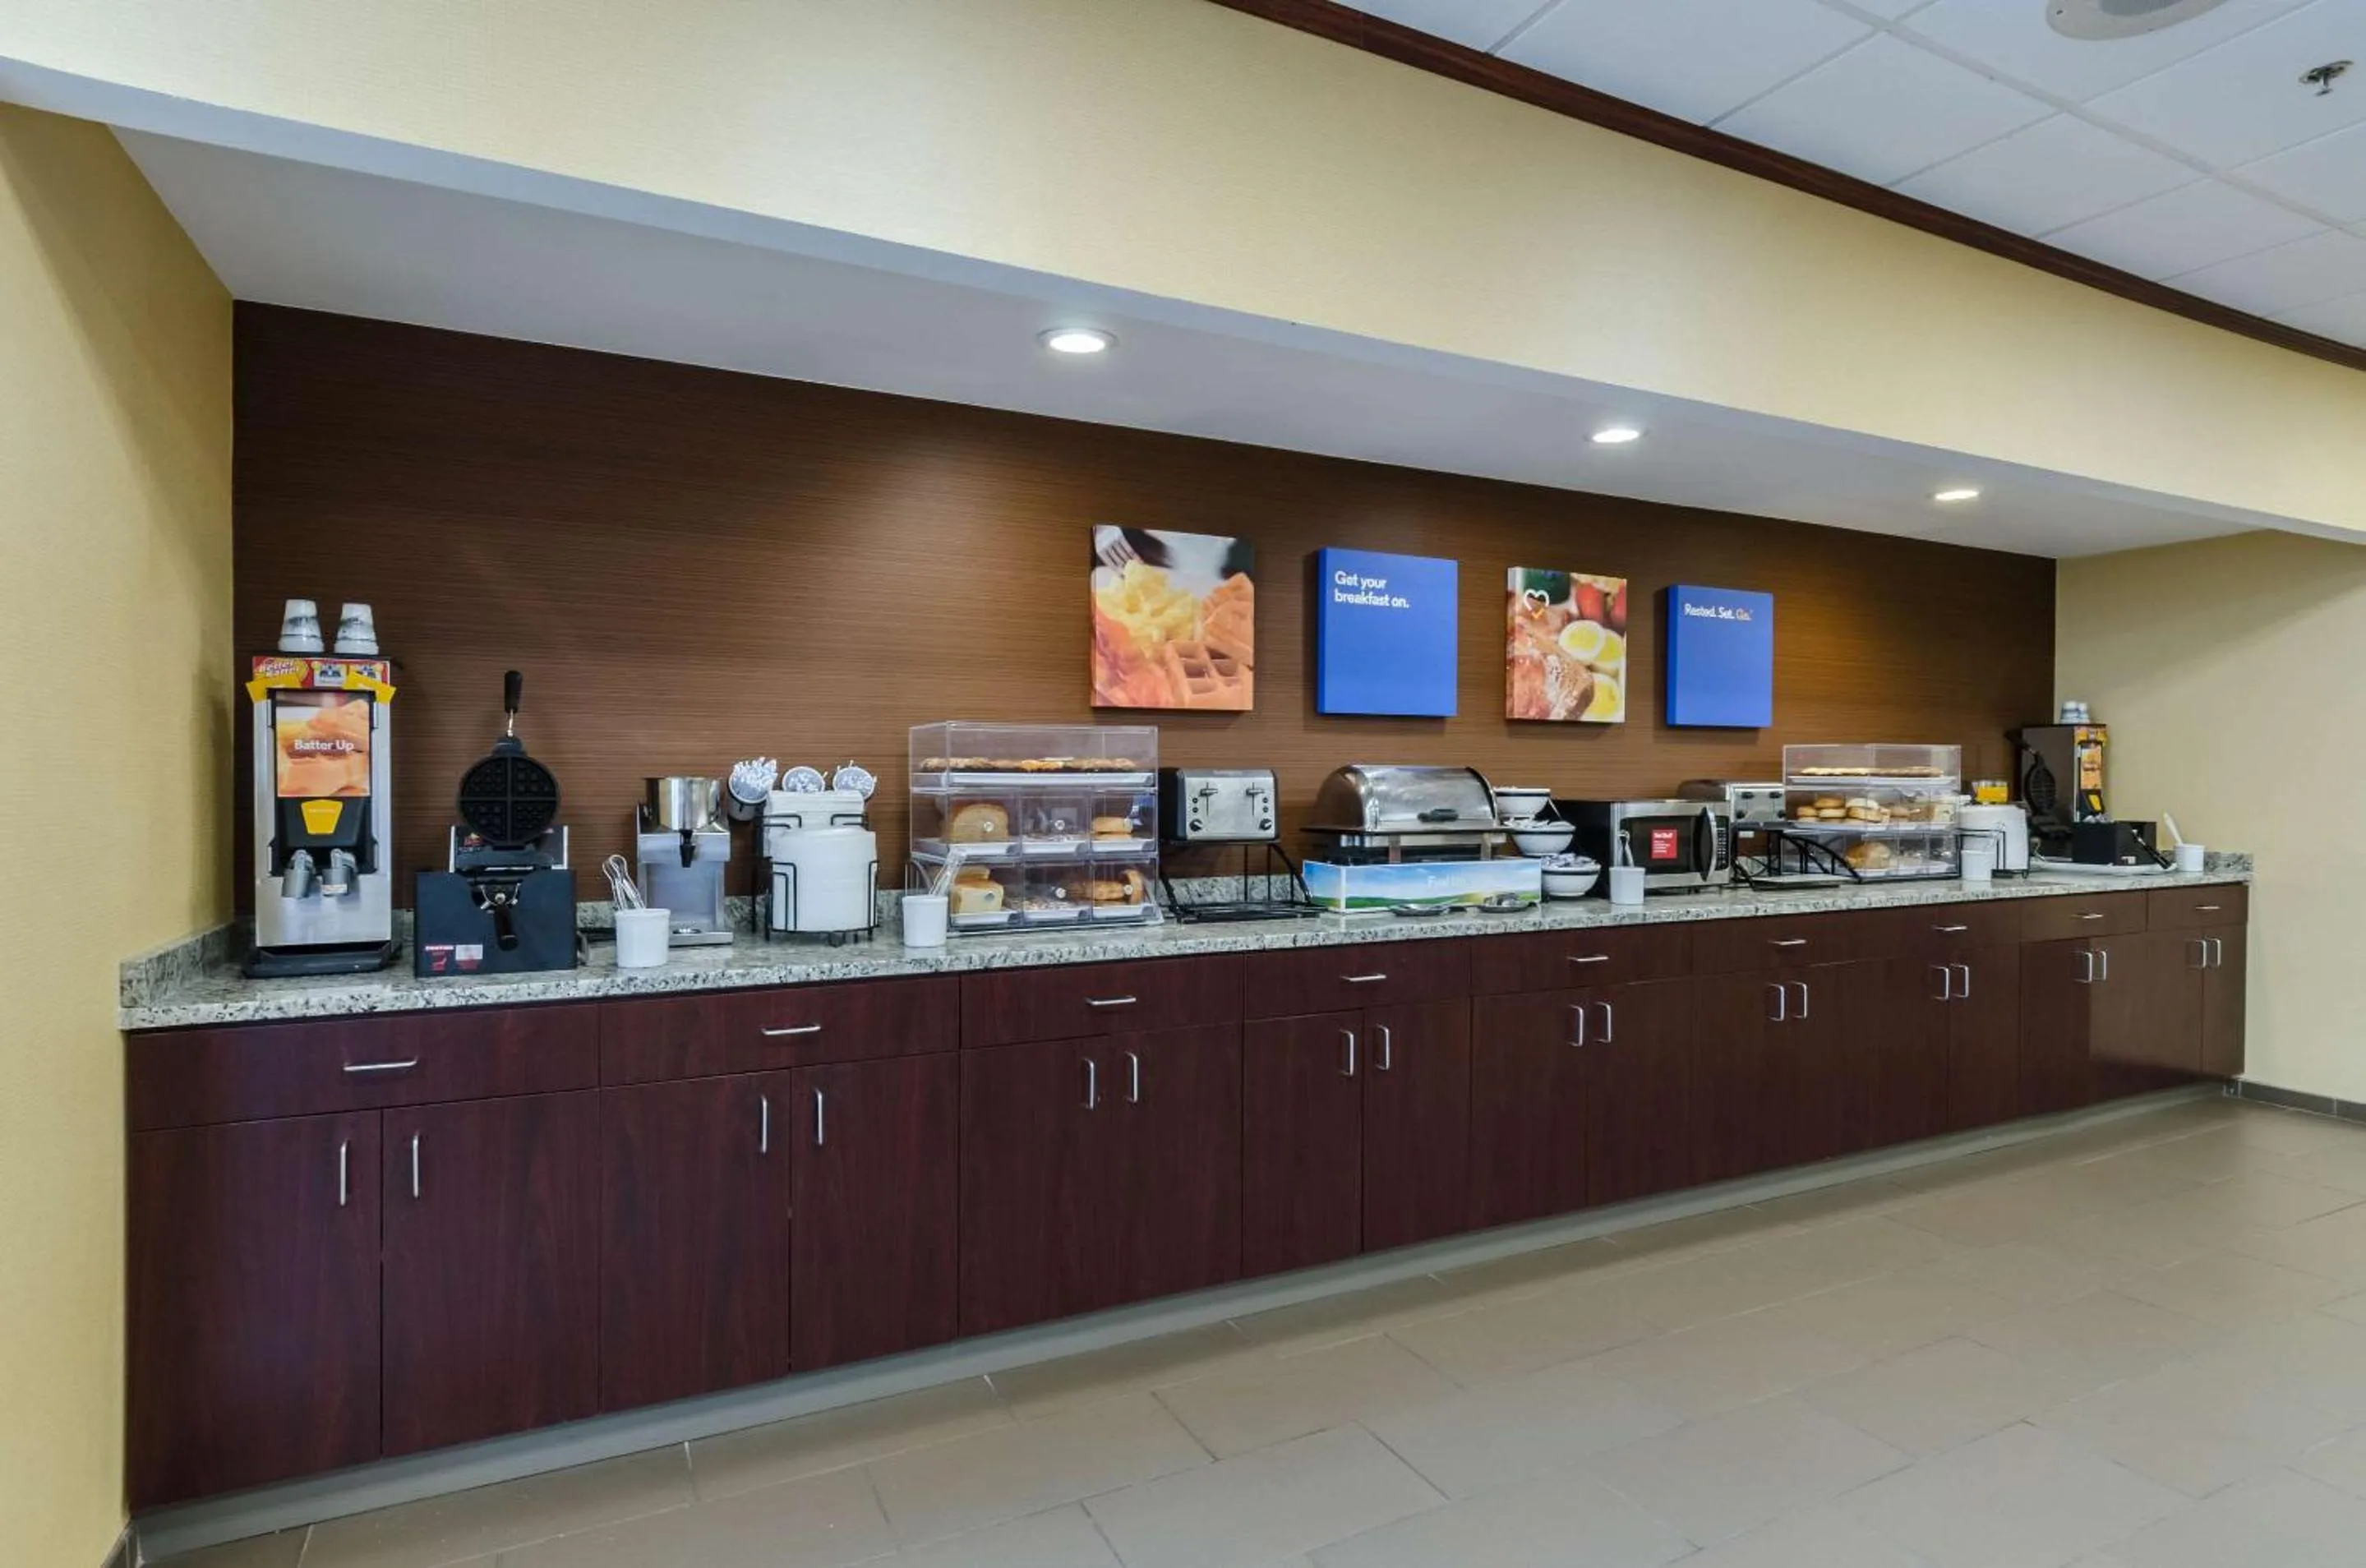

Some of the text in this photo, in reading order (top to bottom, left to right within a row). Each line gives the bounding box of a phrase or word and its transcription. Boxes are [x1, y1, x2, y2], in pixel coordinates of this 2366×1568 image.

[1335, 570, 1387, 591] Get your
[1335, 588, 1410, 608] breakfast on.
[294, 739, 354, 753] Batter Up
